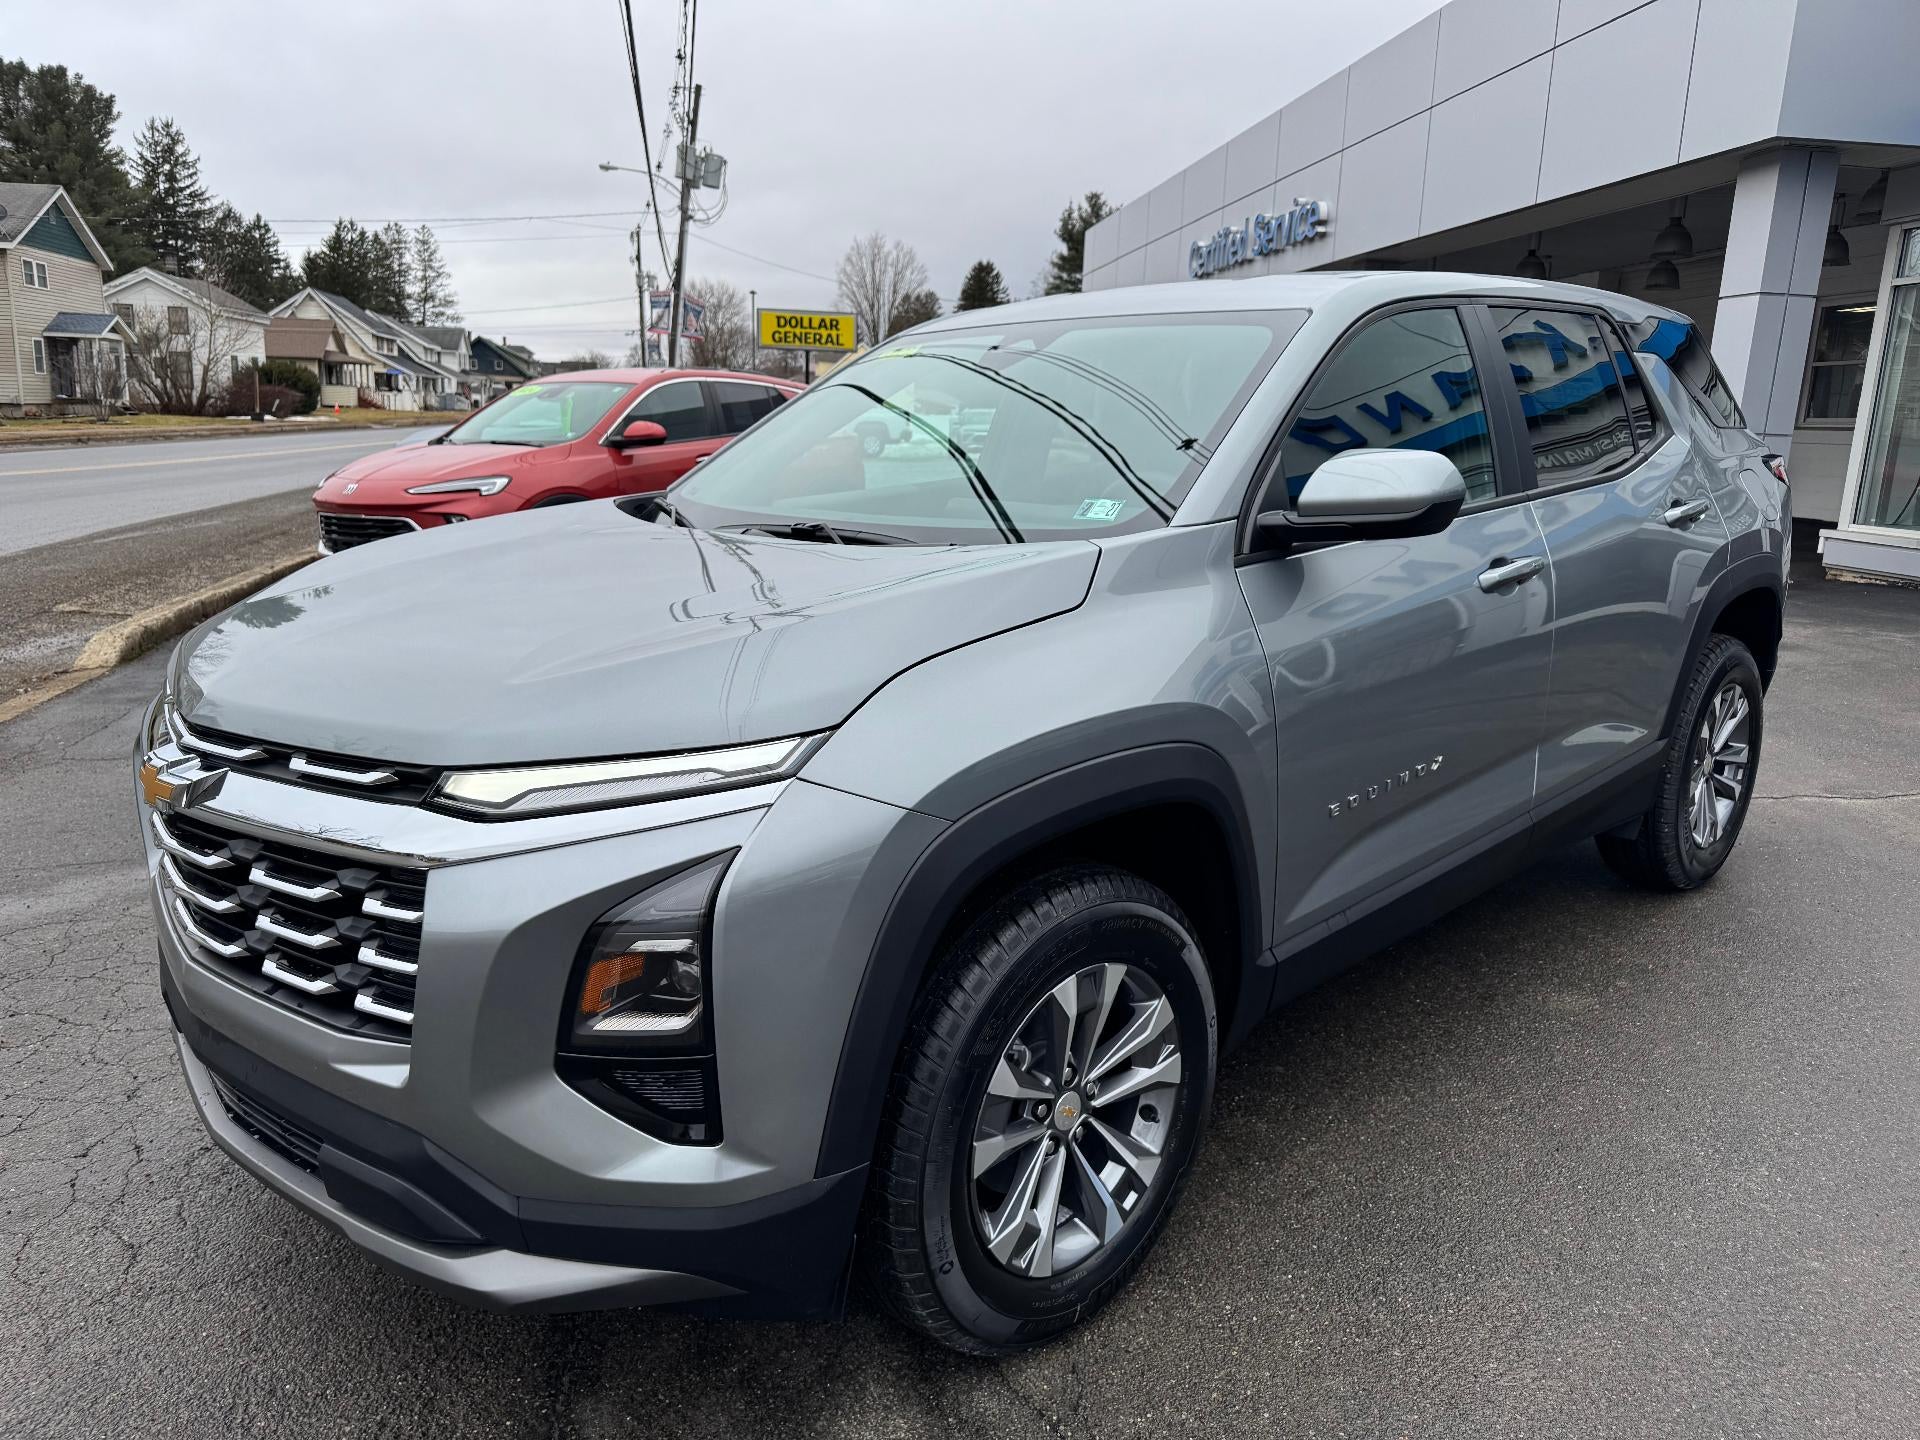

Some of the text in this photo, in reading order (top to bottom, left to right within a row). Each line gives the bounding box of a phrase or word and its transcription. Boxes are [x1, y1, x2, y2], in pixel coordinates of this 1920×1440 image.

[1252, 197, 1329, 257] Service
[776, 315, 841, 331] DOLLAR
[772, 330, 844, 346] GENERAL
[1105, 502, 1122, 517] 27
[1328, 755, 1444, 818] EQUINOX
